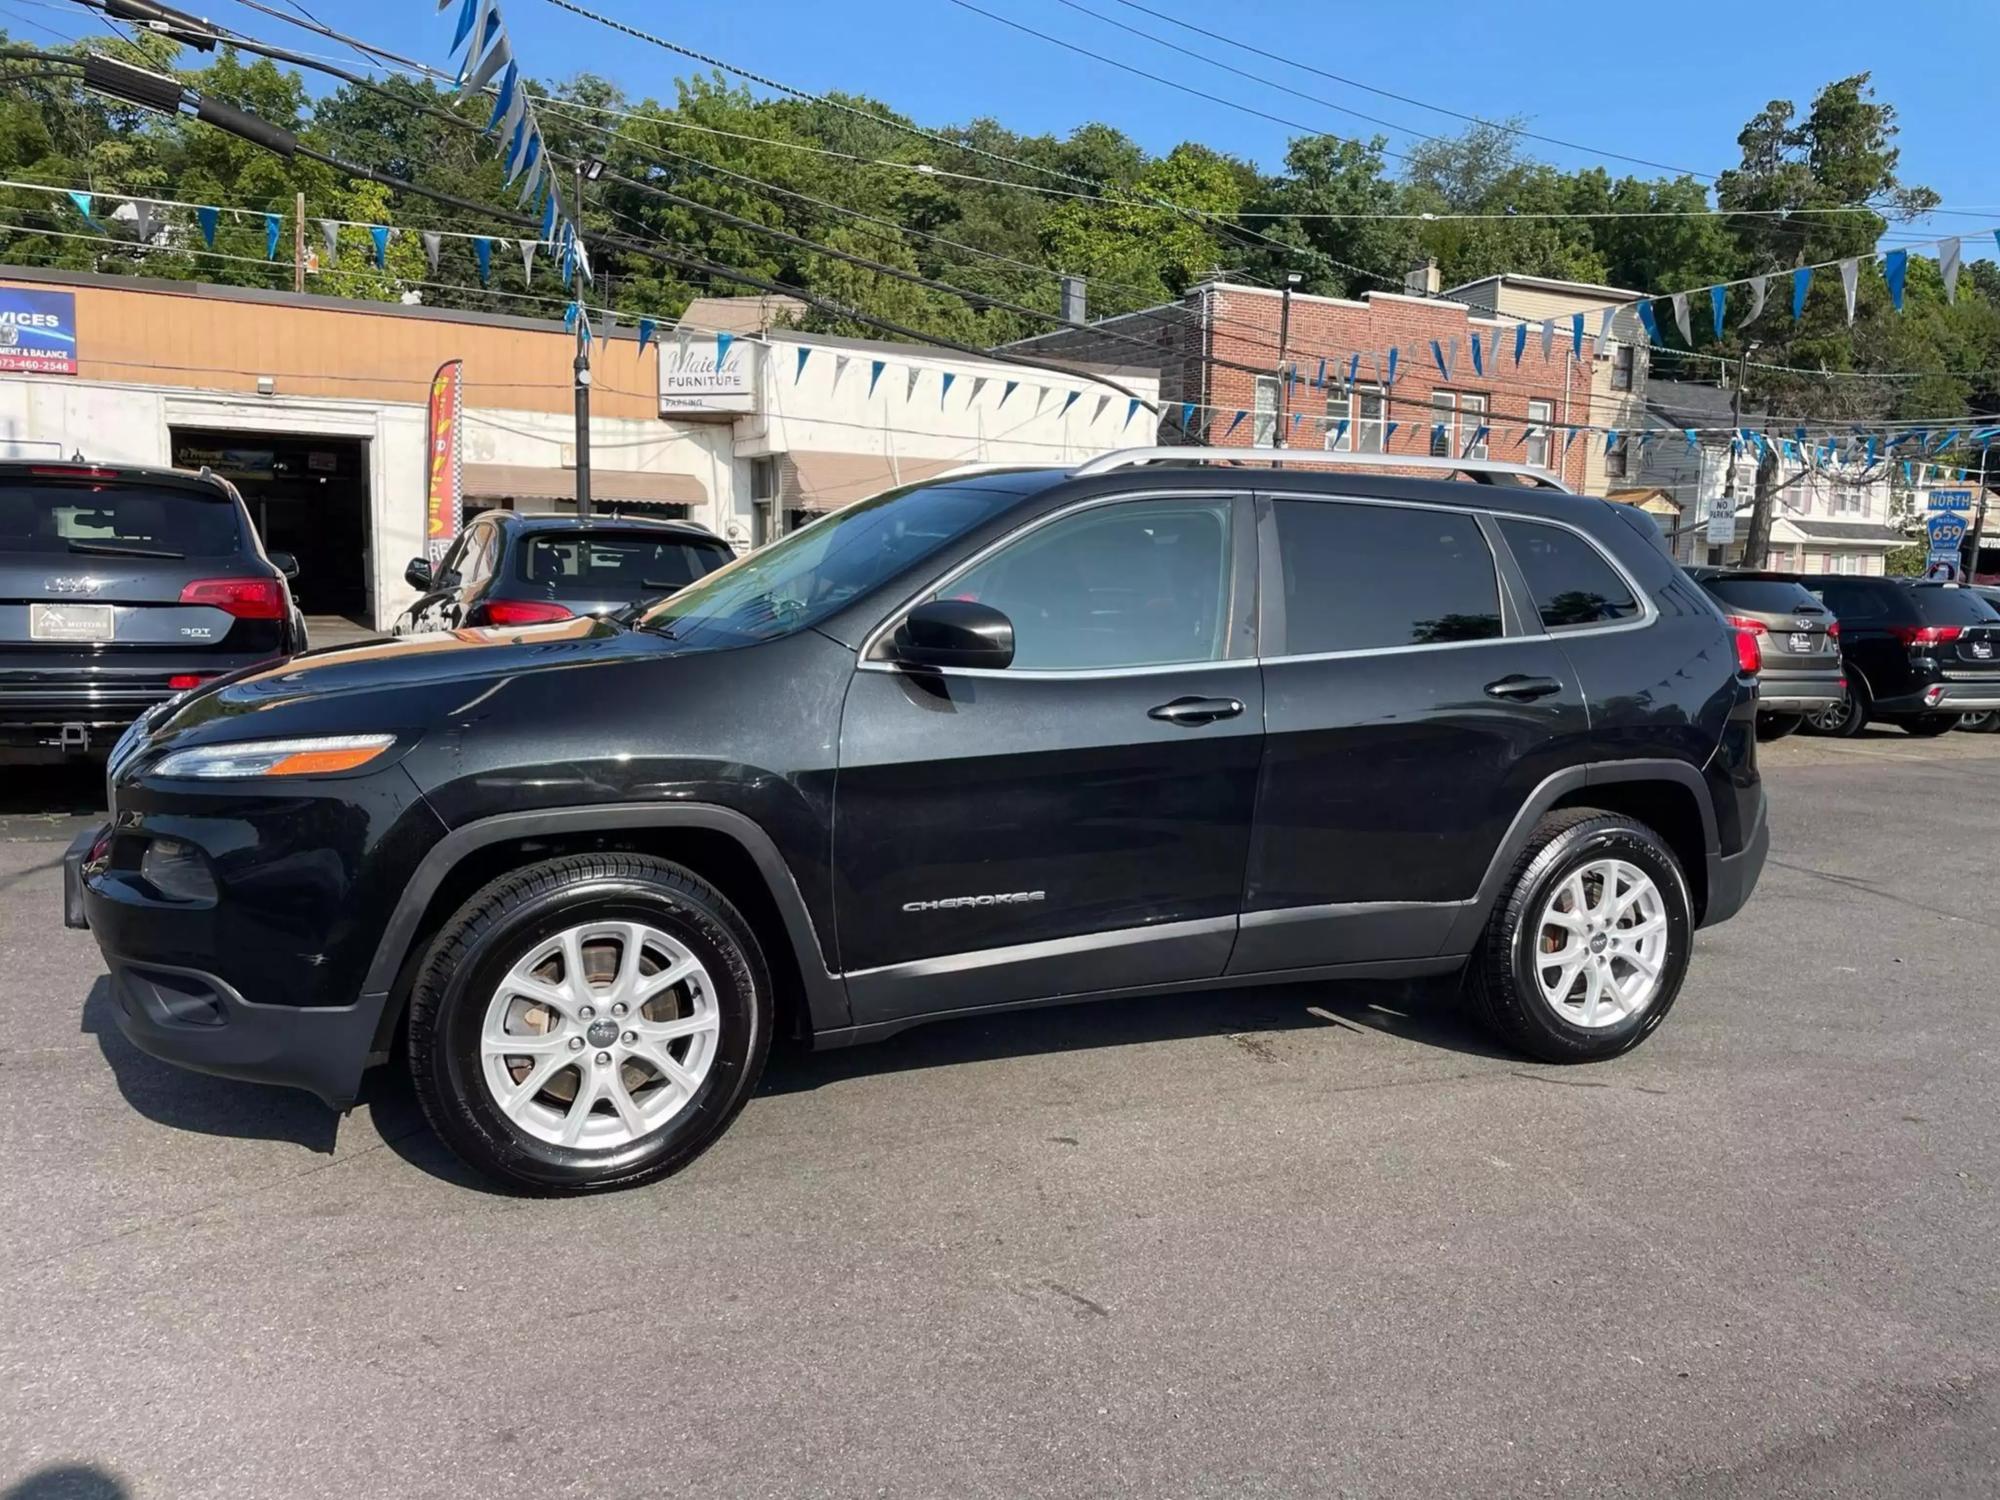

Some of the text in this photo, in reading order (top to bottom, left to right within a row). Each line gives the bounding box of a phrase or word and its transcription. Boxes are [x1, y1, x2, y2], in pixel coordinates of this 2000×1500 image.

[22, 349, 29, 357] &
[30, 349, 68, 359] BALANCE
[0, 358, 69, 371] 73-460-2546
[668, 375, 742, 387] FURNITURE
[1716, 501, 1728, 510] NO
[1929, 494, 1970, 507] NORTH
[1932, 525, 1961, 541] 659
[902, 891, 1046, 912] CHEROKEE
